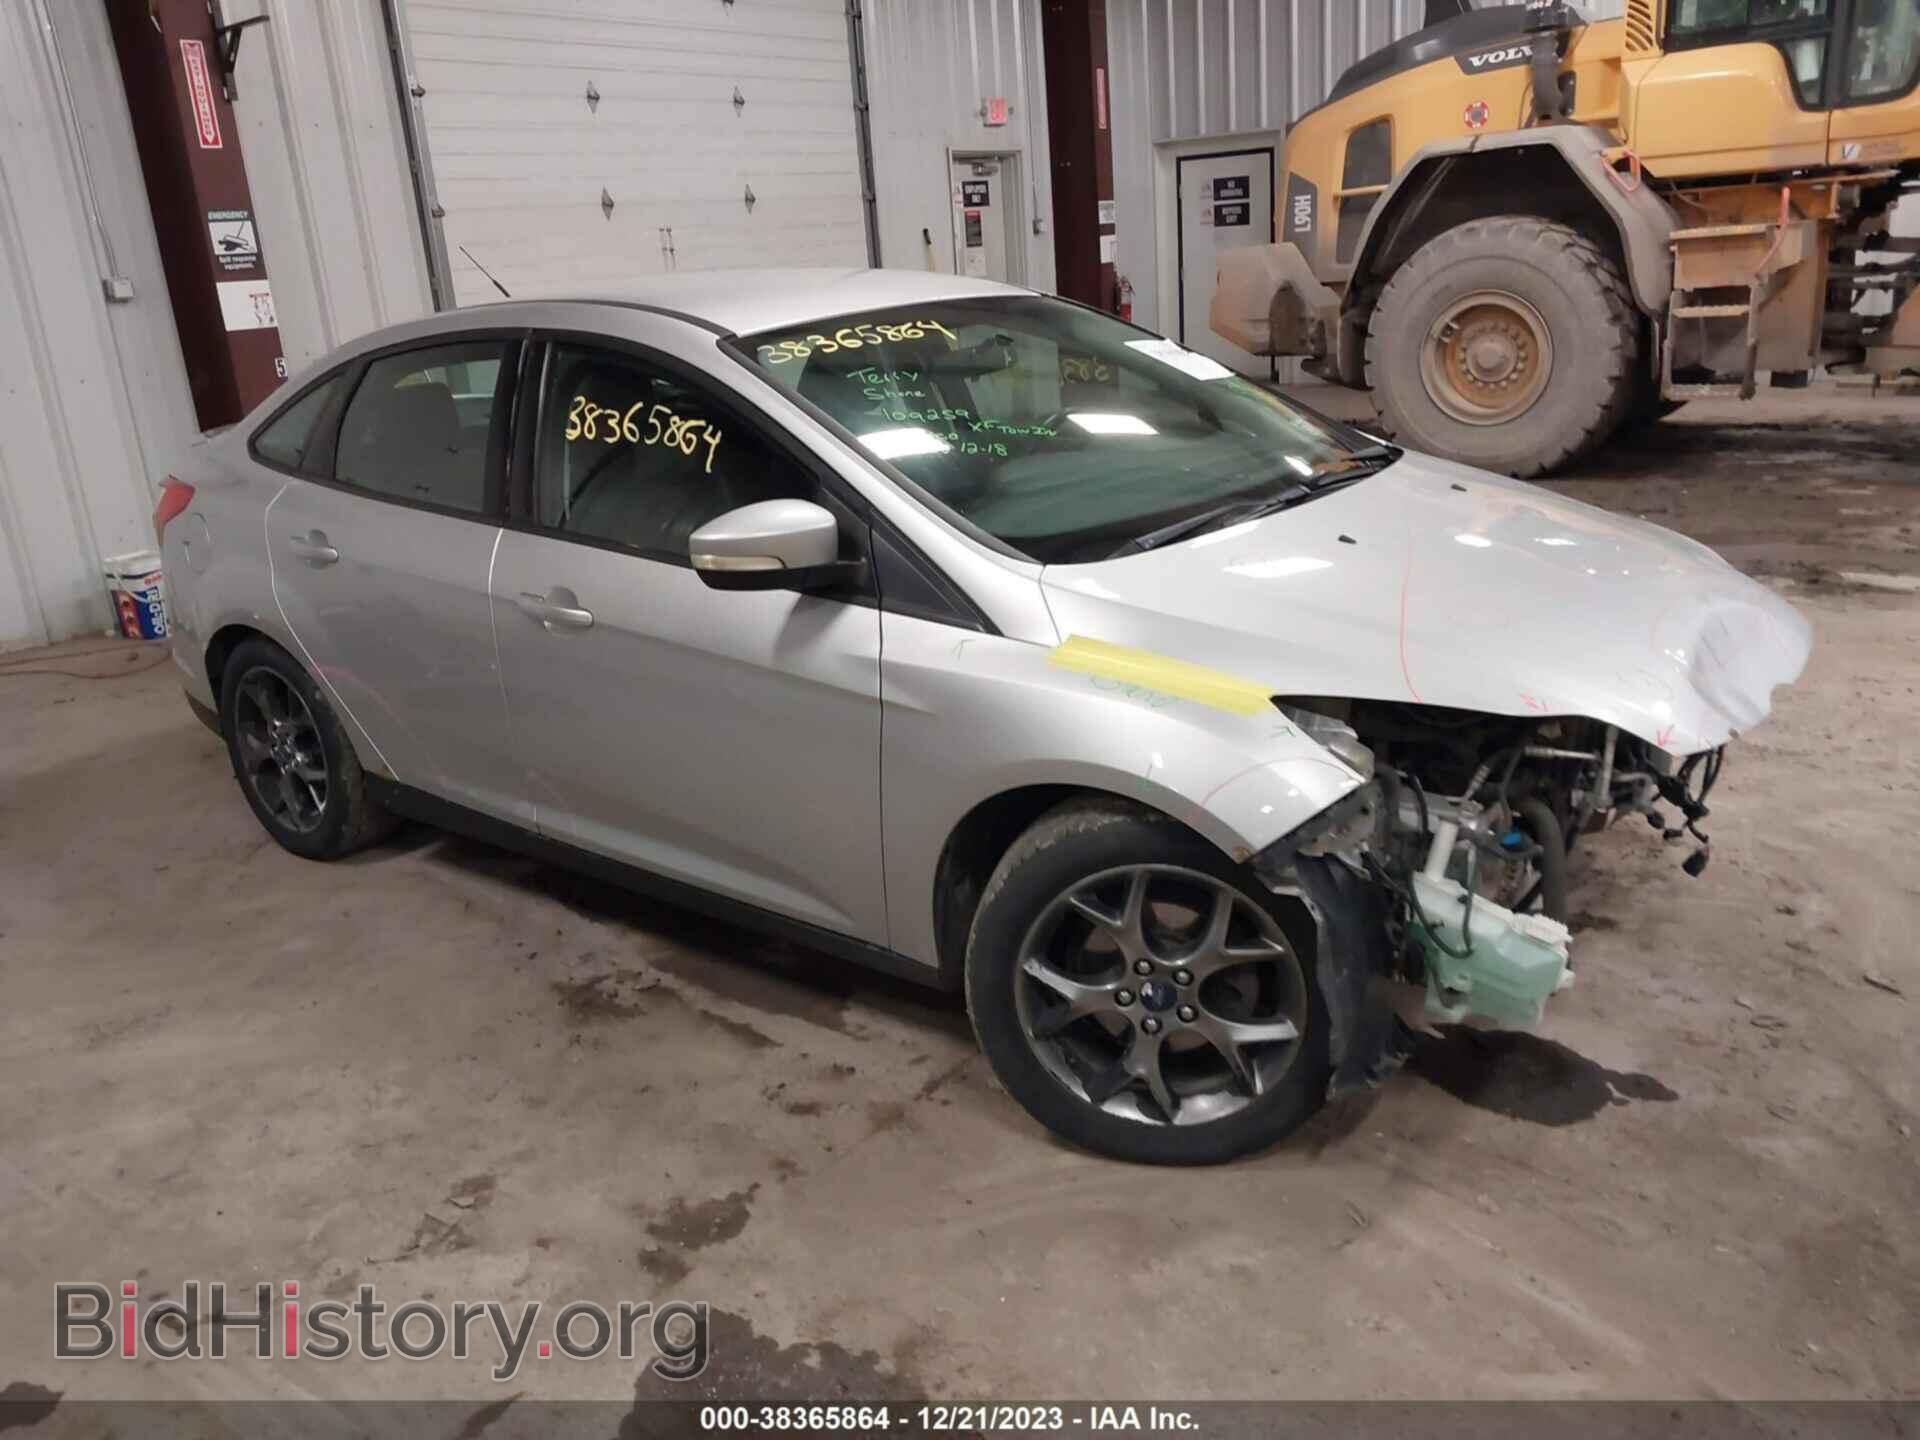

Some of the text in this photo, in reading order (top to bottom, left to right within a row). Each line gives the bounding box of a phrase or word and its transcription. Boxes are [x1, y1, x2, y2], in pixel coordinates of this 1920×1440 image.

[1468, 45, 1535, 67] VOLV
[1294, 194, 1311, 232] L90H
[757, 320, 958, 364] 38365864
[276, 359, 286, 377] 5
[565, 396, 722, 474] 38365864
